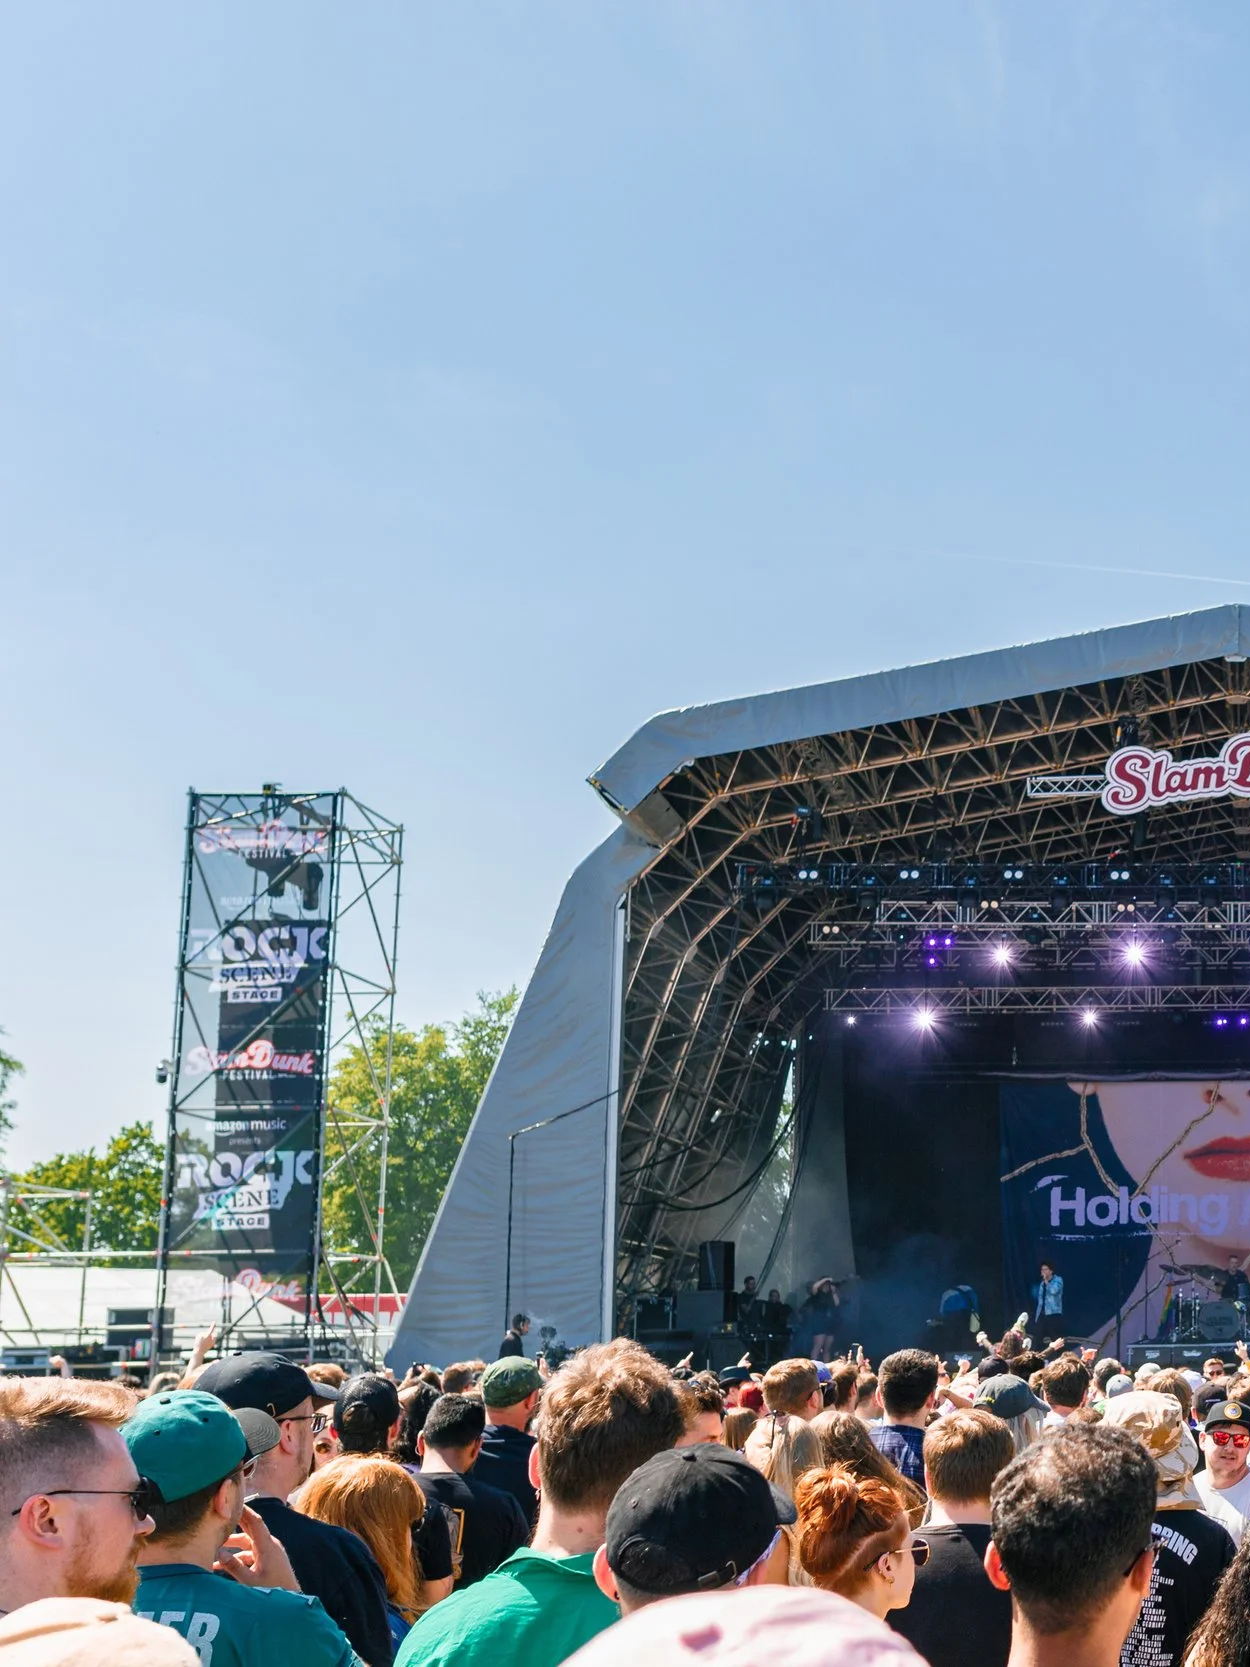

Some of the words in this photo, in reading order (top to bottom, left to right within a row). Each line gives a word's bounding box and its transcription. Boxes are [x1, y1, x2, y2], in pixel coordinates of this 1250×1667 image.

[1107, 750, 1229, 808] Slam
[219, 964, 292, 984] SCENE
[231, 990, 279, 1000] STAGE
[222, 1069, 274, 1081] FESTIVAL
[204, 1119, 250, 1134] amazon
[250, 1117, 286, 1131] music
[203, 1188, 281, 1211] SCENE
[1050, 1185, 1230, 1236] Holding
[217, 1217, 266, 1227] STAGE
